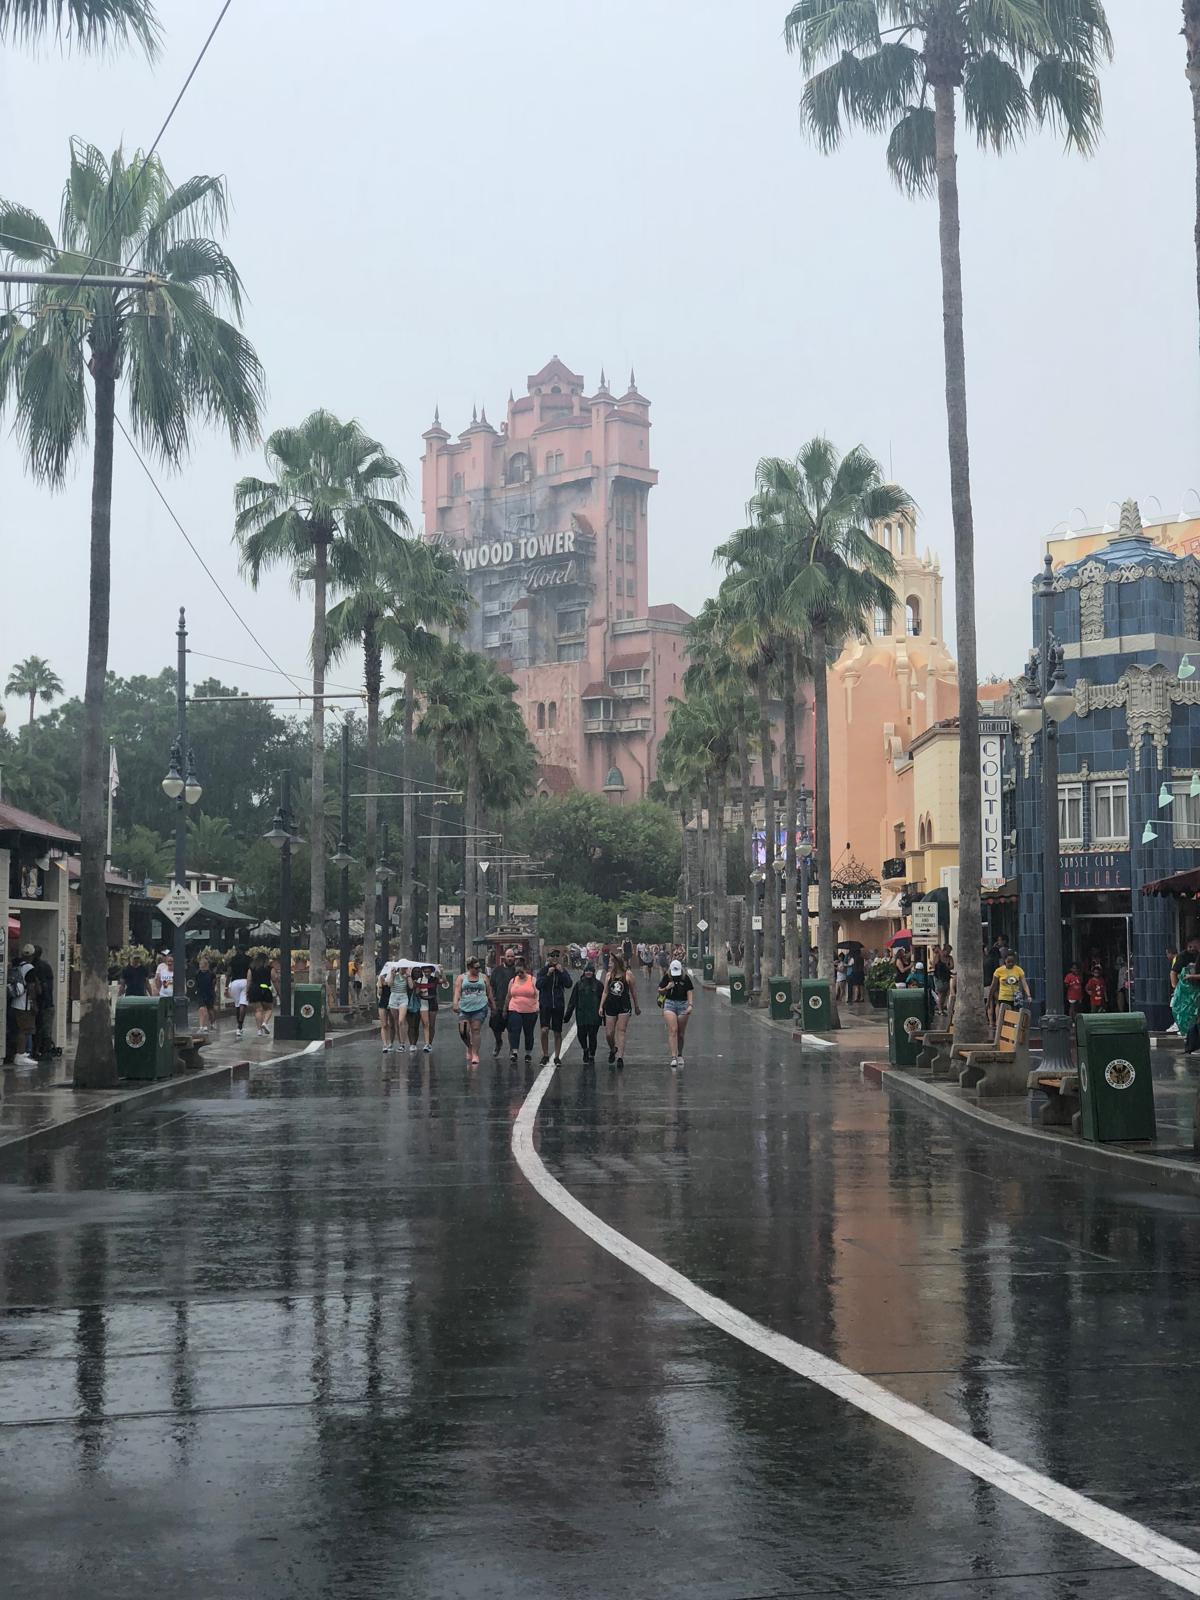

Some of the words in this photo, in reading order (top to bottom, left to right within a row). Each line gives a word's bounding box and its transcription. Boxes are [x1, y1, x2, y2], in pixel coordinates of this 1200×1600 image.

[452, 541, 513, 571] YWOOD
[519, 531, 575, 560] TOWER
[524, 560, 575, 589] Hotel
[983, 741, 998, 872] COUTURE
[1060, 856, 1088, 868] SUNSET
[1064, 870, 1120, 886] OUTURE
